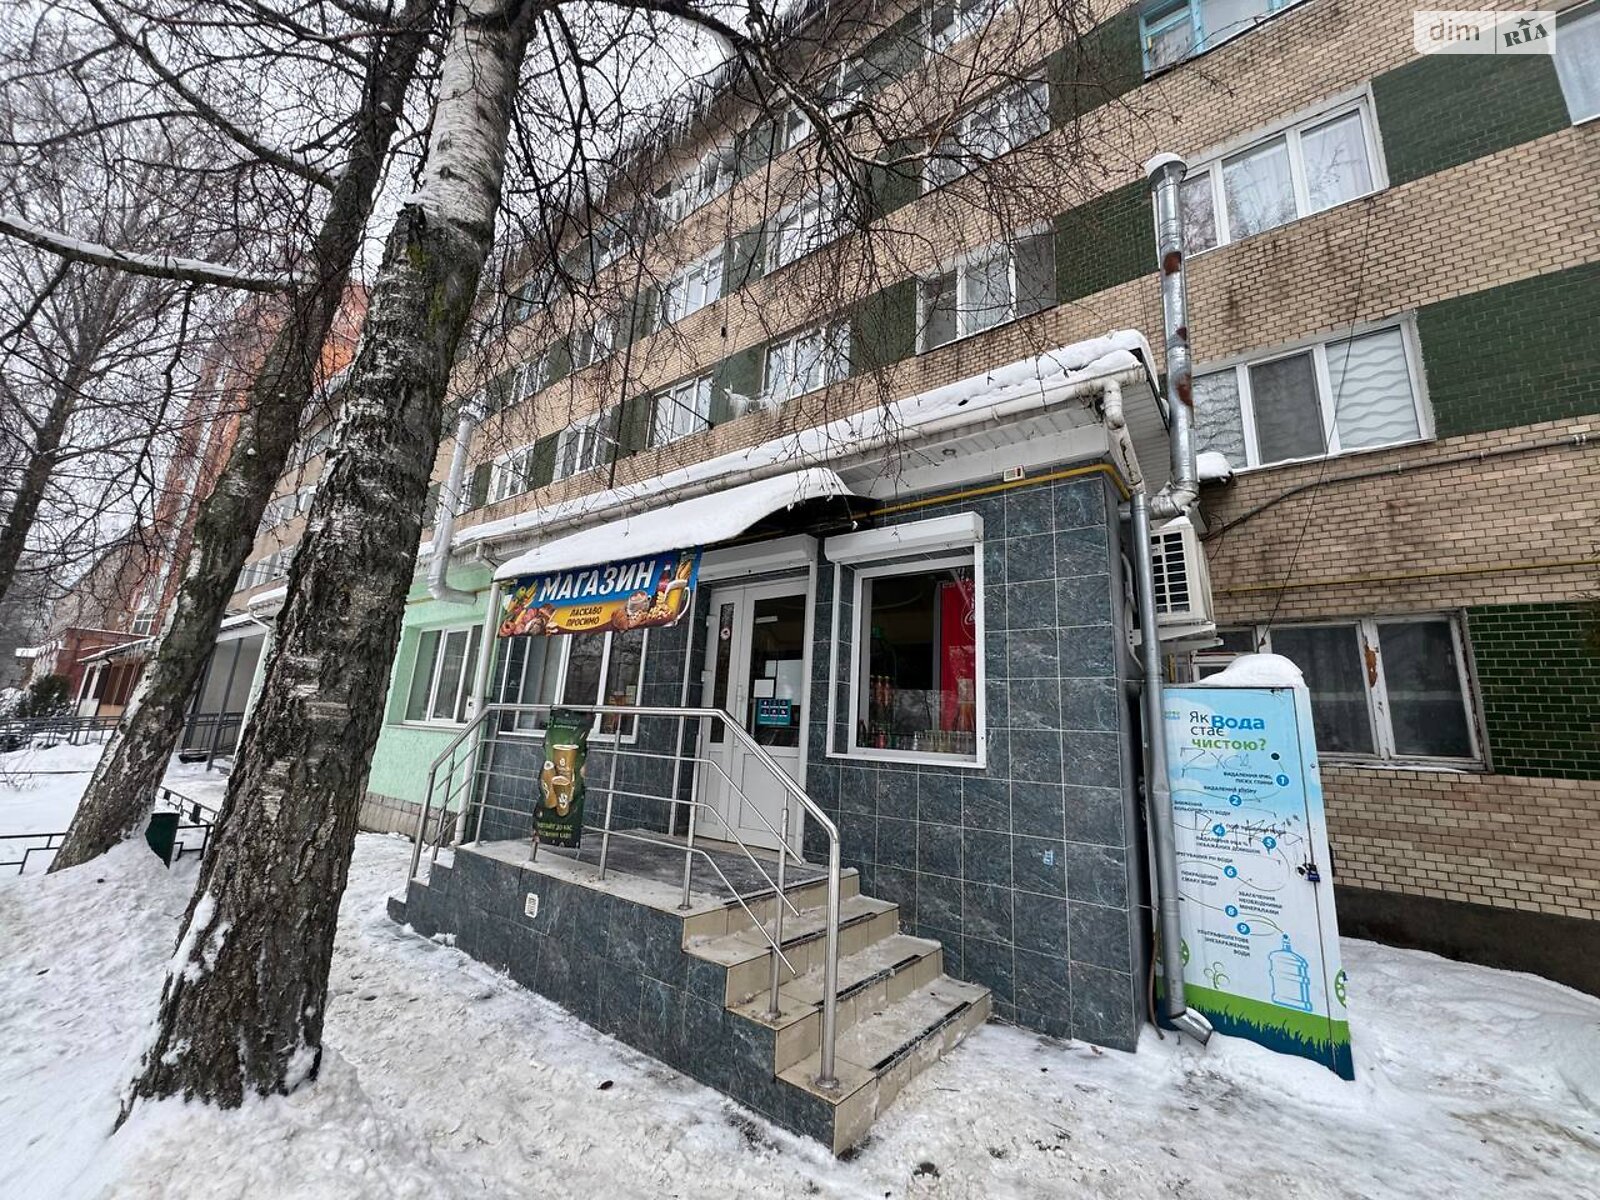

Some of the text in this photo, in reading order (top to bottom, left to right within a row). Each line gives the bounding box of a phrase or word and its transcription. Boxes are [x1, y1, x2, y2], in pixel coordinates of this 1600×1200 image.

[538, 560, 656, 602] МАГАЗИН
[570, 606, 602, 618] ЛАСКАВО
[565, 616, 600, 627] ПРОСИМО
[1189, 711, 1209, 723] Як
[1211, 715, 1265, 730] Вода
[1191, 726, 1225, 736] стає
[1192, 738, 1267, 751] чистою?
